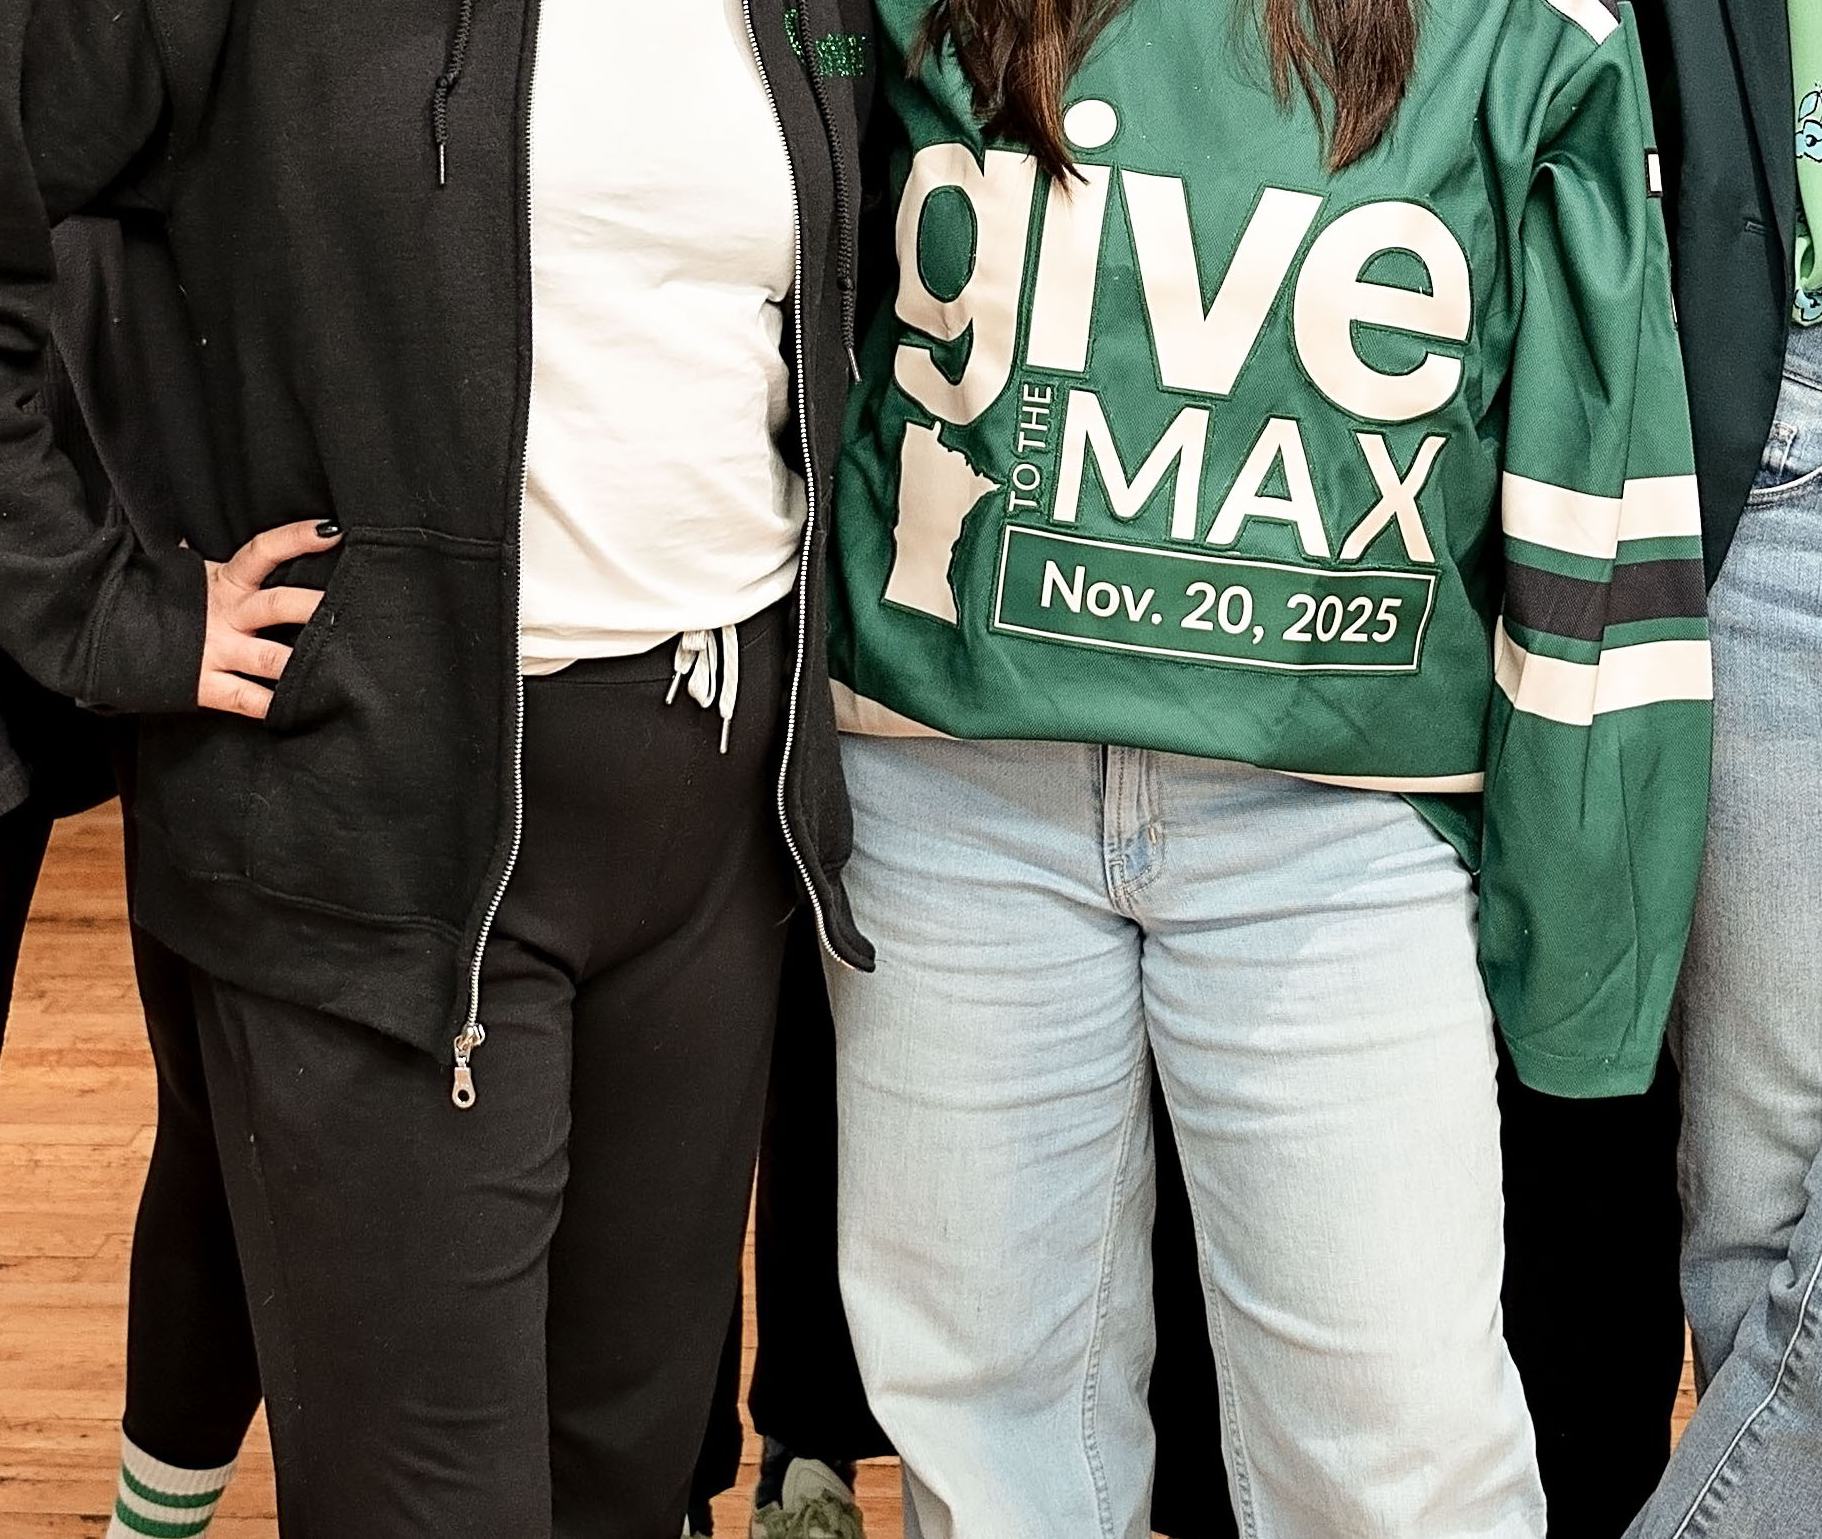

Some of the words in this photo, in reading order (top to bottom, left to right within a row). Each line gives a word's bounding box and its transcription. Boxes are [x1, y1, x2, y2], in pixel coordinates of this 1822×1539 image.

[894, 98, 1473, 426] give
[1016, 383, 1052, 452] THE
[1009, 463, 1041, 512] TO
[1052, 388, 1448, 563] MAX
[1040, 559, 1164, 626] Nov.
[1180, 582, 1266, 646] 20,
[1282, 593, 1404, 643] 2025
